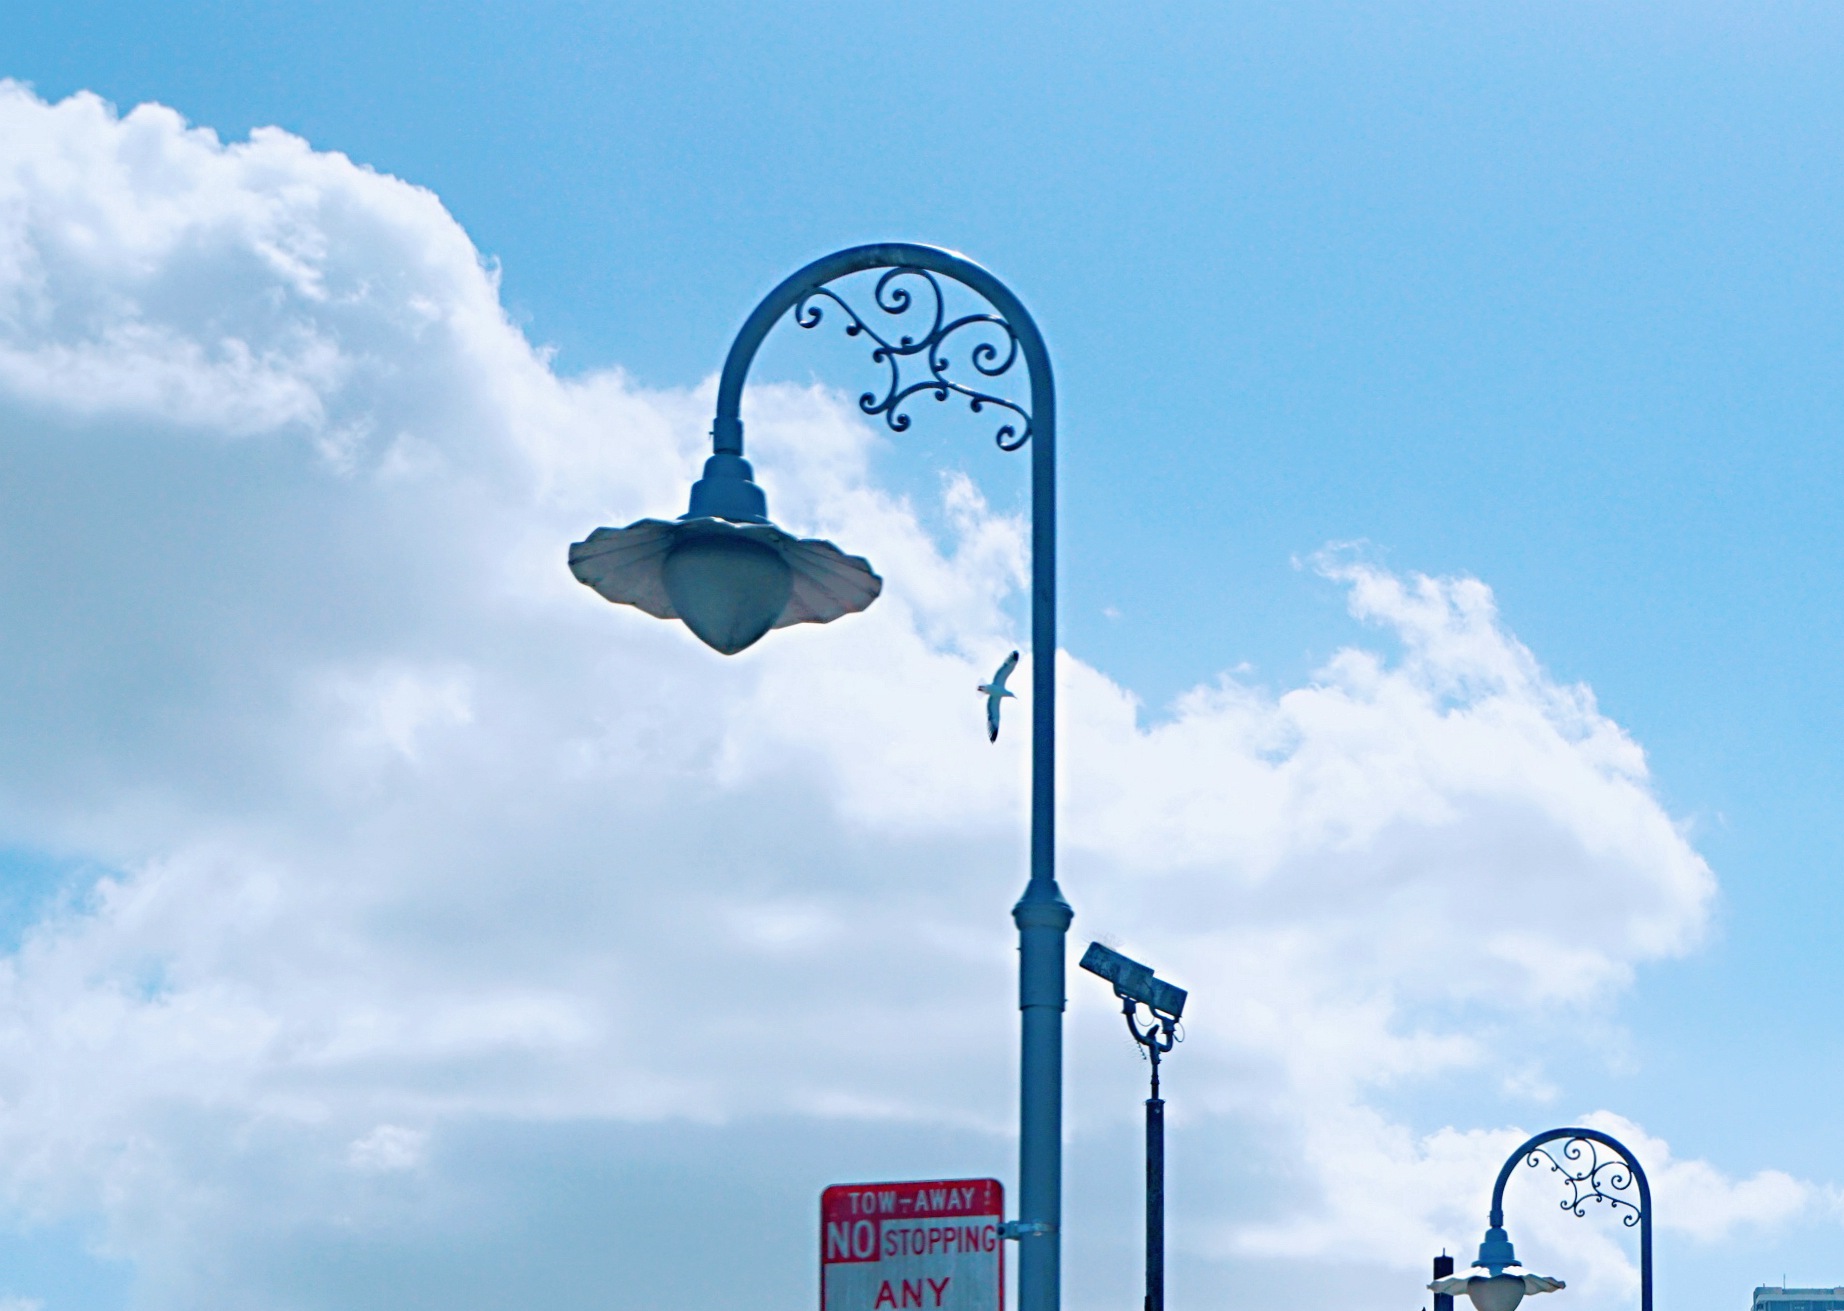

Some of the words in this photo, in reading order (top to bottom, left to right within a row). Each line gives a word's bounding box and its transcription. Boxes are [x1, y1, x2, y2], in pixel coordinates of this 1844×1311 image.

[848, 1187, 975, 1214] TOW-AWAY
[827, 1220, 876, 1259] NO
[885, 1225, 996, 1256] STOPPING
[874, 1277, 950, 1310] ANY
